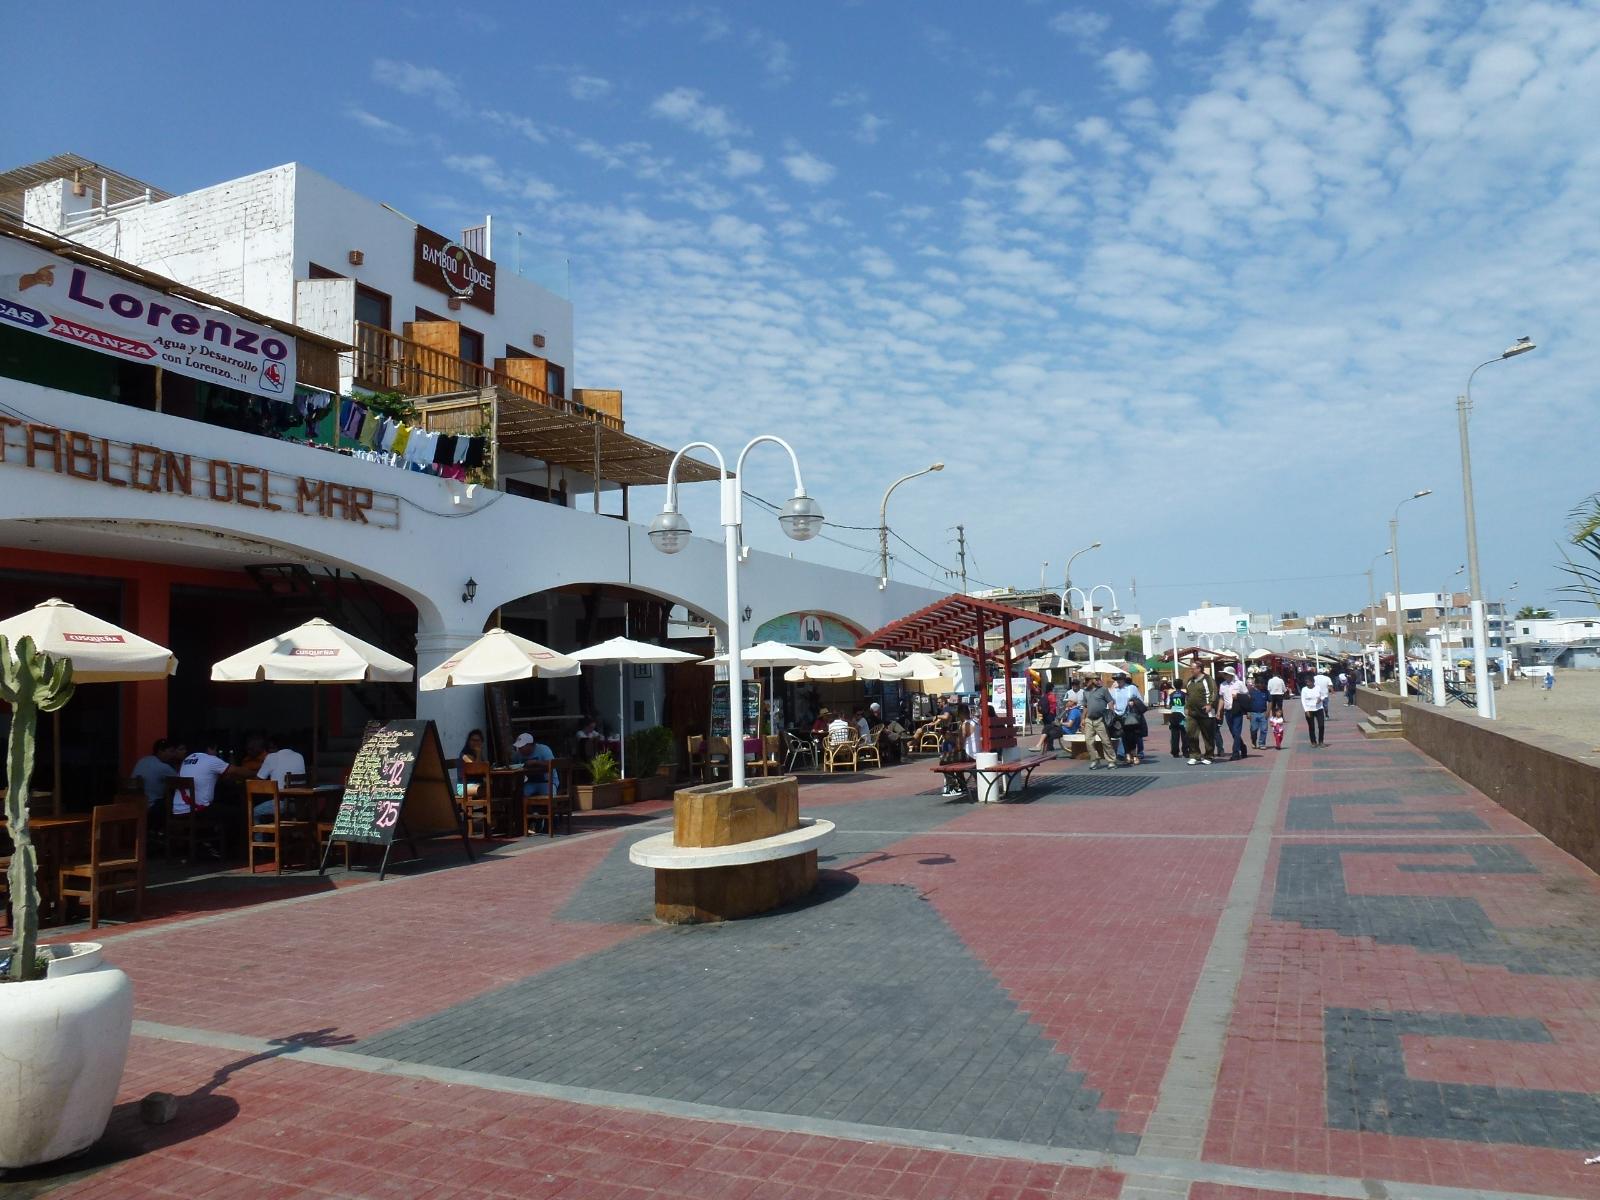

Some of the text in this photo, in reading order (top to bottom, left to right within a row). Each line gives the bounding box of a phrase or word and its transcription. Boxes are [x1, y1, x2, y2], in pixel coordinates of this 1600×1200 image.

[422, 243, 491, 291] BAMBOO LODGE
[69, 268, 288, 360] Lorenzo
[56, 323, 148, 357] AVANZA
[153, 335, 258, 373] Agua y Desarrollo
[161, 352, 182, 365] con
[209, 460, 281, 511] DEL
[297, 475, 374, 524] MAR
[389, 760, 404, 785] 12
[377, 801, 399, 827] 25
